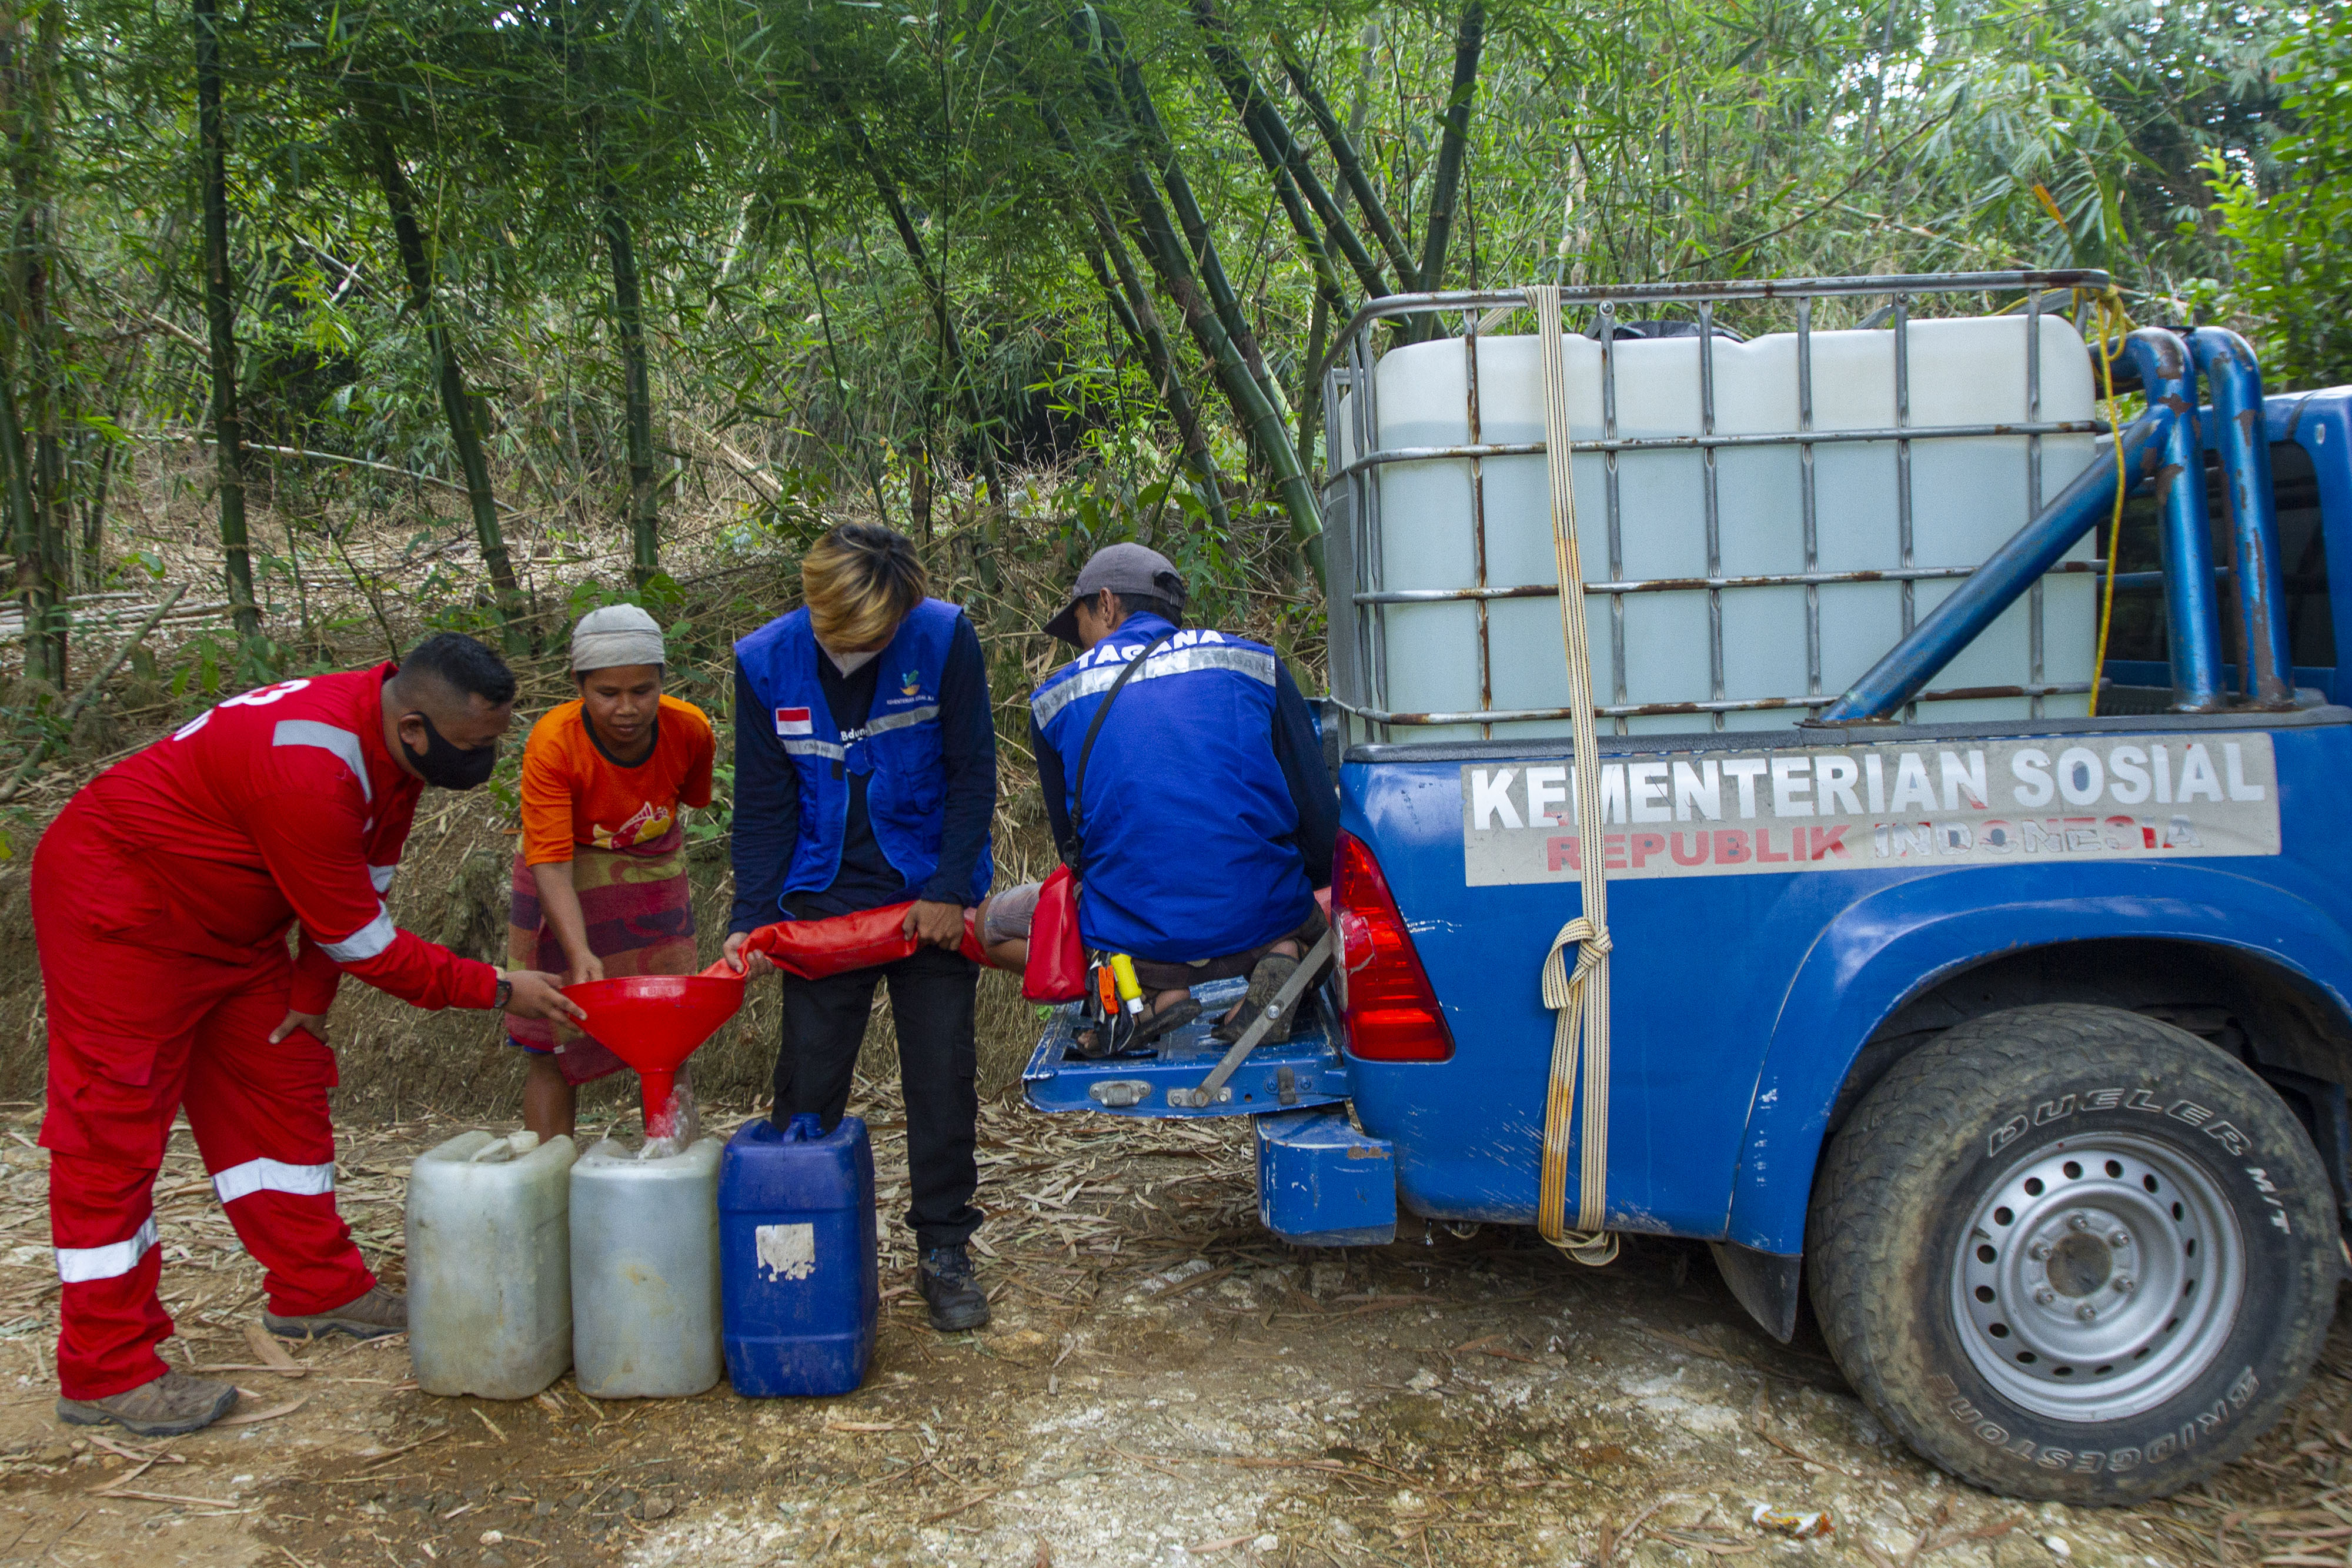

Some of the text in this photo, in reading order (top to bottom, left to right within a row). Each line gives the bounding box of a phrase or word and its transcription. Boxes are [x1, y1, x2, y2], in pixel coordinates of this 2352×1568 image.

[1472, 743, 2266, 830] KEMENTERIAN SOSIAL
[1546, 814, 2204, 872] REPUBLIK INDONESIA
[1987, 1088, 2291, 1234] DUELER M/T
[1930, 1365, 2259, 1474] BRIDGESTONE
